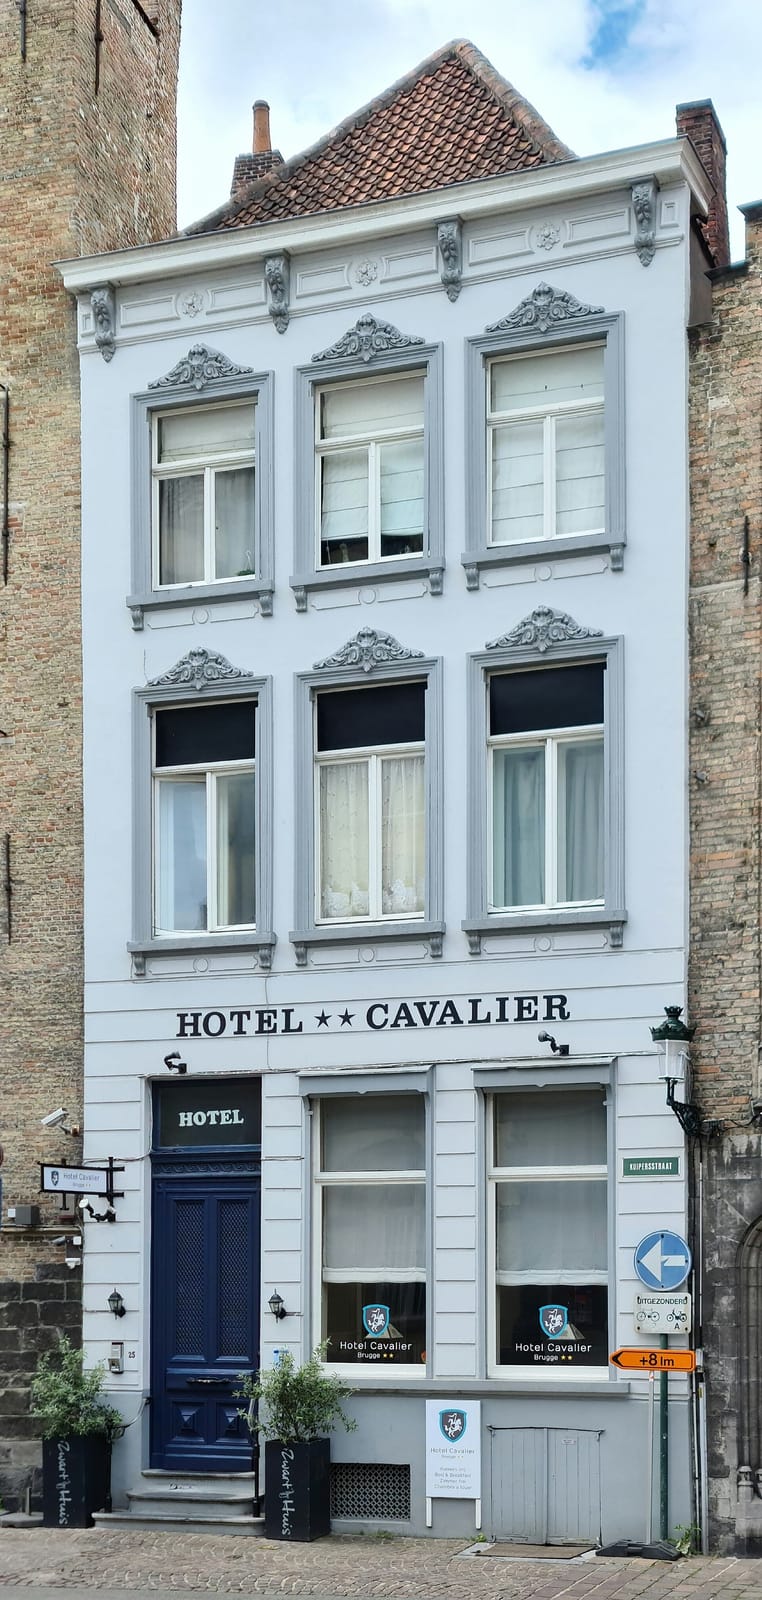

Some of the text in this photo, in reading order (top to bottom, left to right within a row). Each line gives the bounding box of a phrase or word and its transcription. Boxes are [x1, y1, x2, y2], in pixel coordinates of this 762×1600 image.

[176, 994, 571, 1037] HOTEL CAVALIER
[178, 1109, 245, 1127] HOTEL
[629, 1162, 673, 1171] KUIPERSSTRAAT
[637, 1297, 688, 1305] UITGEZONDERD
[674, 1322, 680, 1330] A
[340, 1341, 413, 1351] Hotel Cavalier
[515, 1343, 592, 1352] Hotel Cavalier
[128, 1351, 136, 1359] 25
[357, 1352, 381, 1360] Brugge
[533, 1354, 559, 1362] Brugge
[640, 1353, 658, 1366] +8
[281, 1499, 296, 1536] Huis
